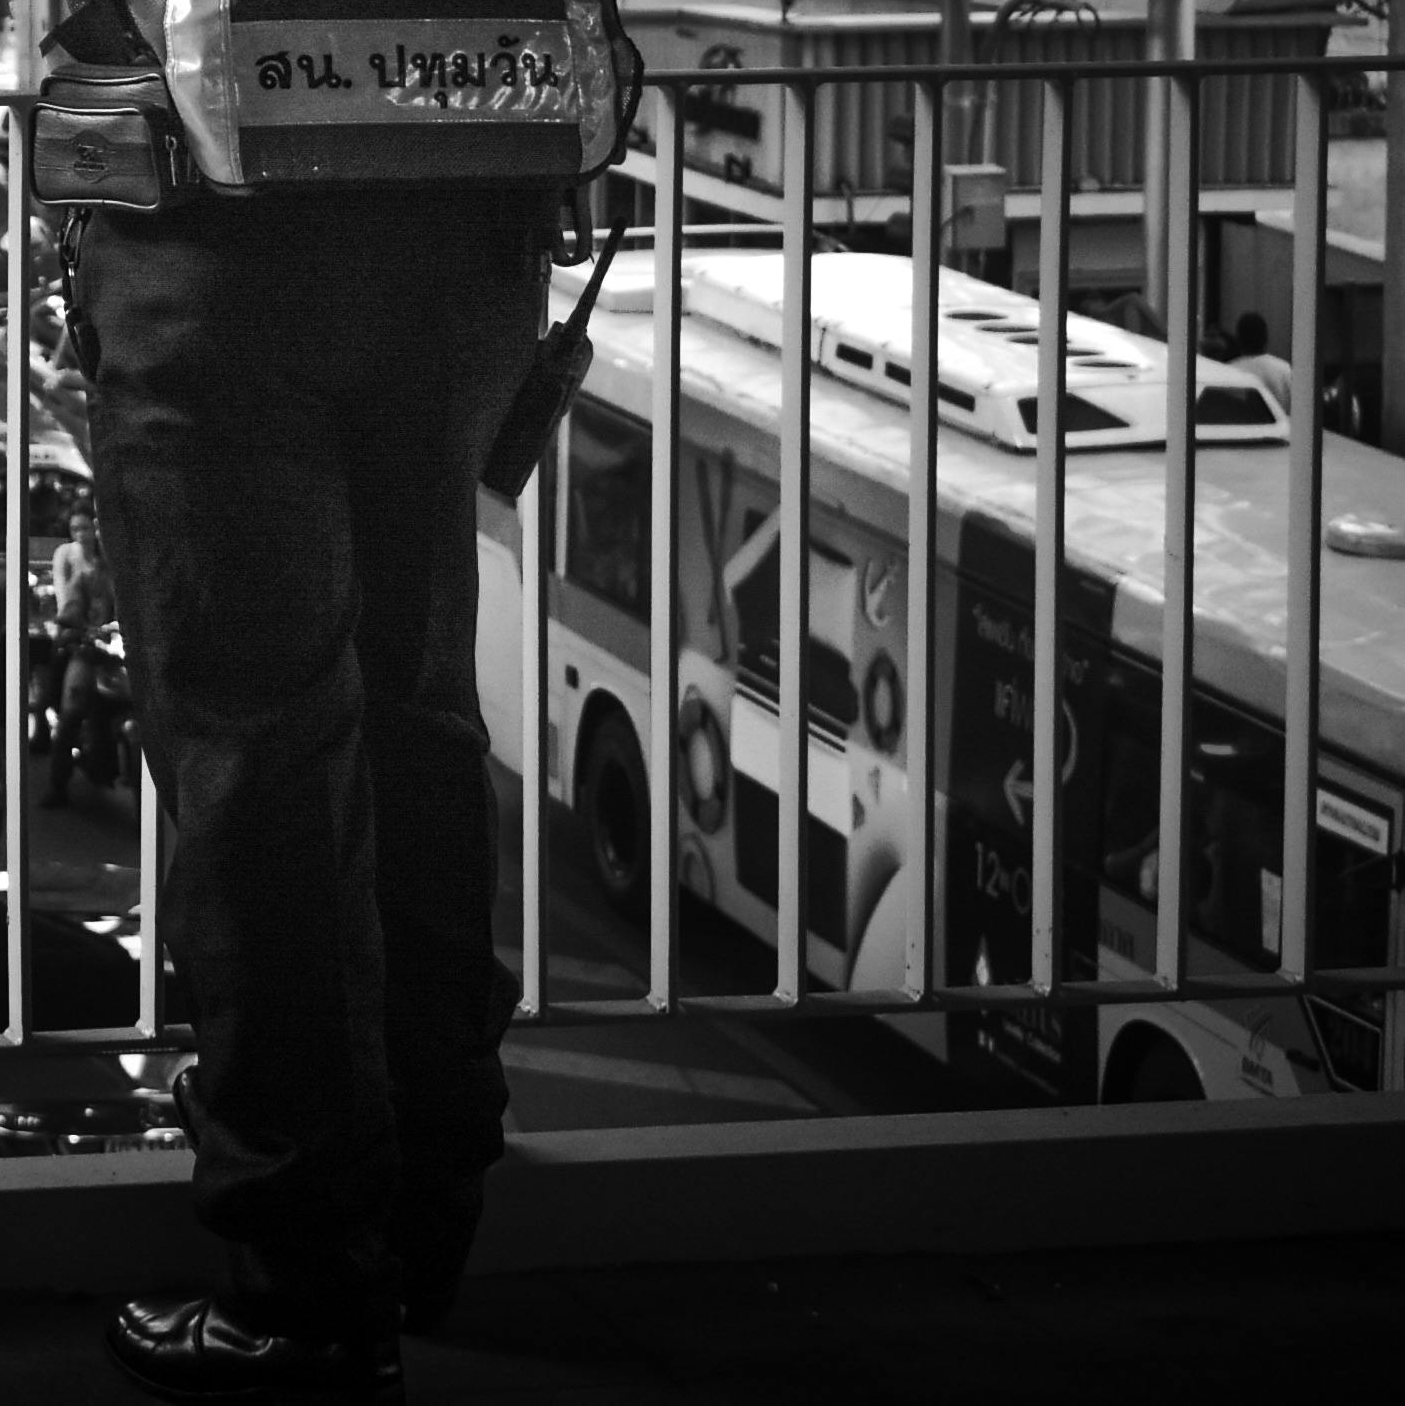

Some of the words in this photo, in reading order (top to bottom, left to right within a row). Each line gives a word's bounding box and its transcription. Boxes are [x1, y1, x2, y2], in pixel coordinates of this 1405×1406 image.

[255, 47, 353, 91] สน.
[370, 36, 559, 110] ปทุมวัน
